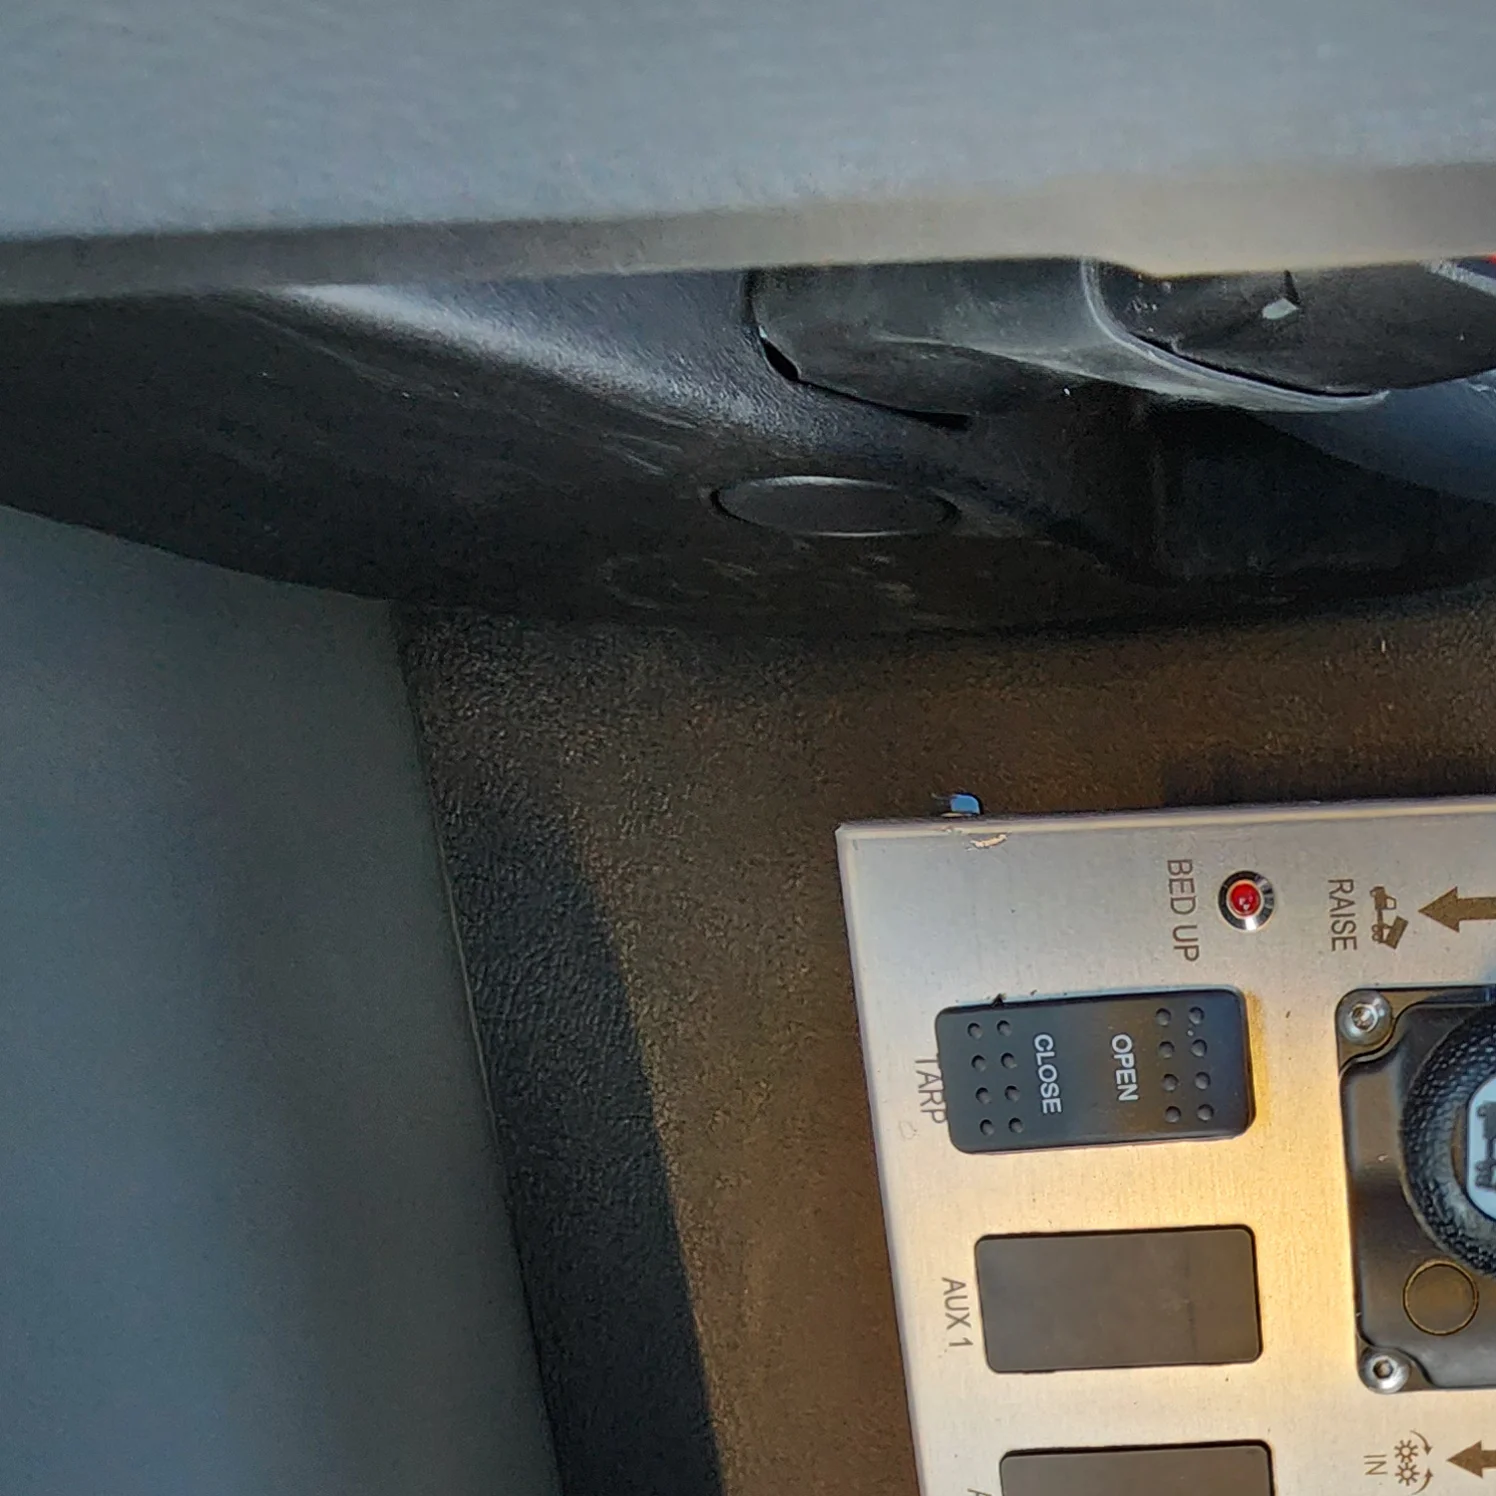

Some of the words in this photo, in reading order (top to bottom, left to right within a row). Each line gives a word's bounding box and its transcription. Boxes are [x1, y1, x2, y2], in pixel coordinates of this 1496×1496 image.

[1167, 859, 1195, 917] BED
[1328, 878, 1357, 952] RAISE
[1172, 924, 1199, 962] UP
[915, 1058, 947, 1124] TARP
[1033, 1034, 1062, 1114] CLOSE
[1111, 1034, 1139, 1102] OPEN
[942, 1276, 969, 1330] AUX
[948, 1337, 973, 1349] 1
[1363, 1453, 1387, 1477] IN
